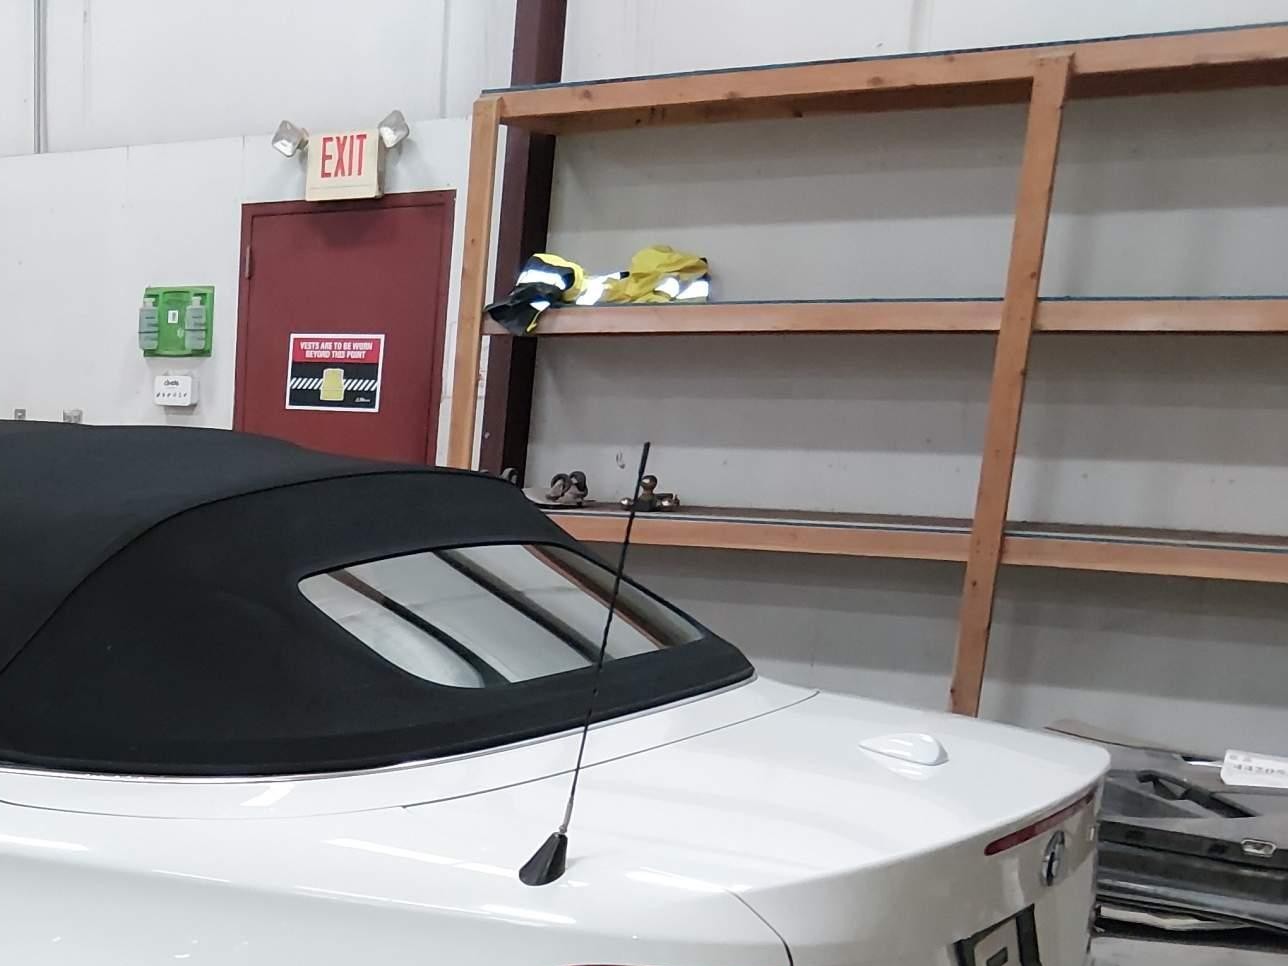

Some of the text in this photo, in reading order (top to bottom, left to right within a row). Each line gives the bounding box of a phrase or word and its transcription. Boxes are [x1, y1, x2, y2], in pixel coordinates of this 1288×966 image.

[321, 134, 367, 178] EXIT
[300, 342, 319, 350] VESTS
[320, 342, 332, 350] ARE
[334, 342, 342, 350] TO
[343, 342, 351, 350] BE
